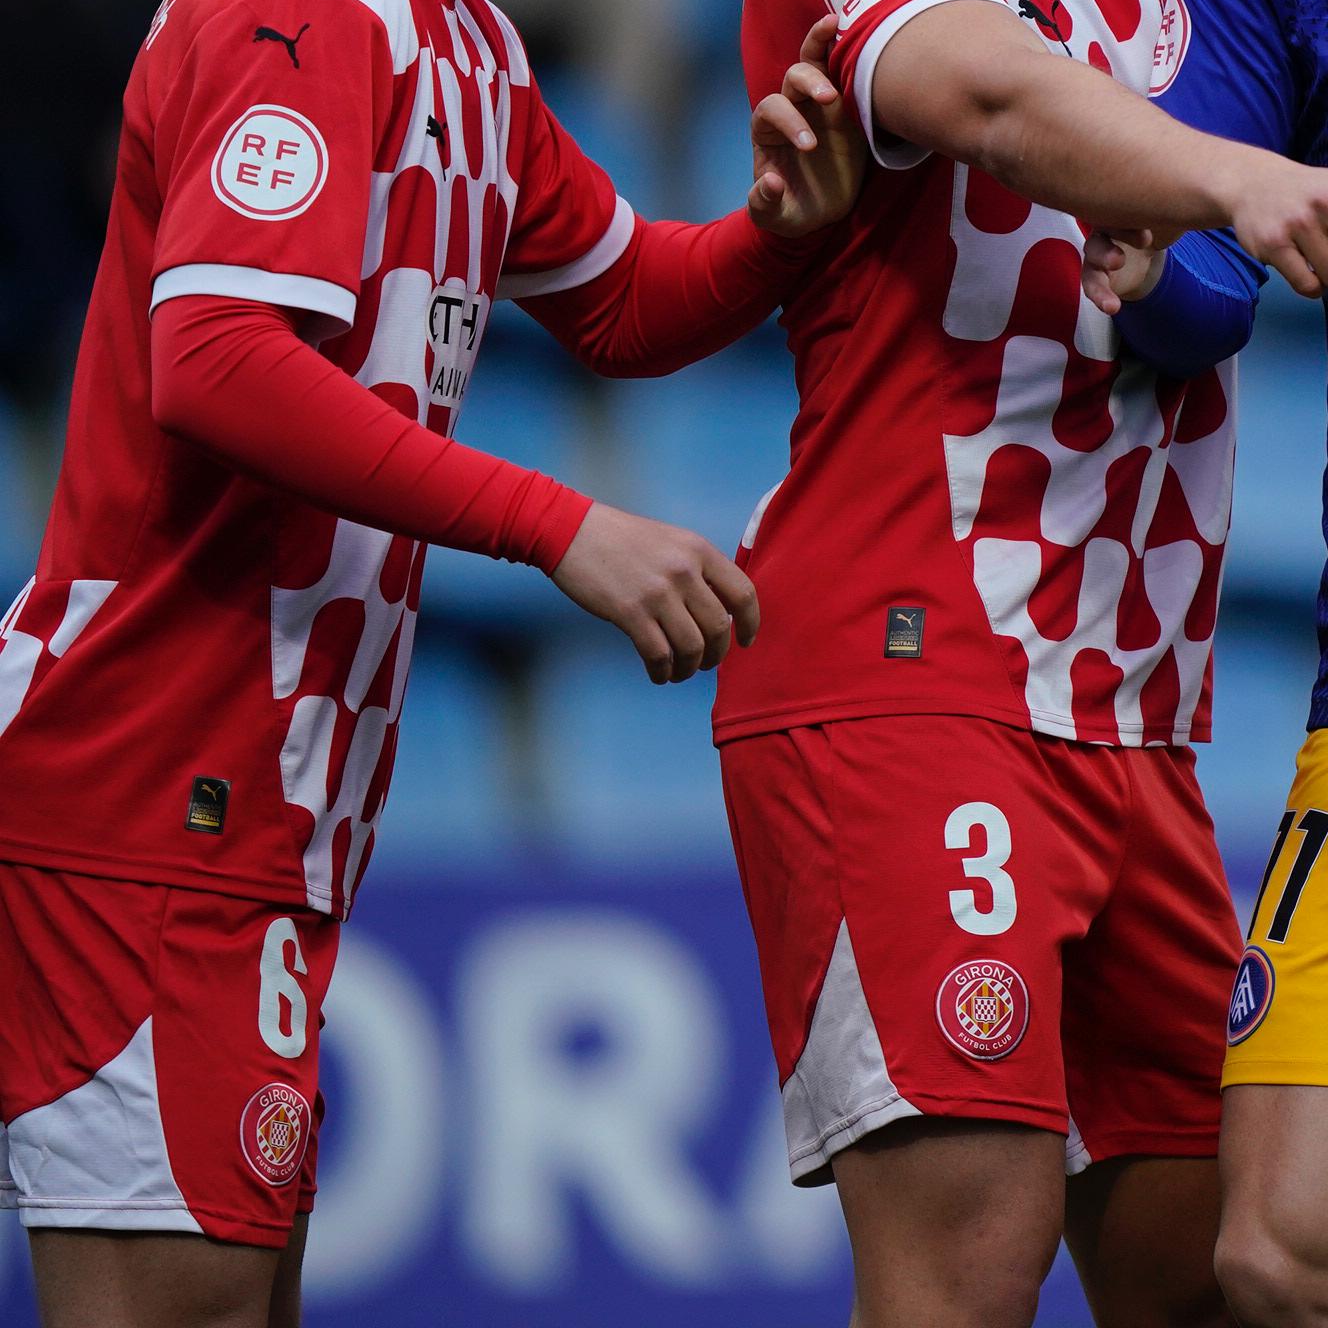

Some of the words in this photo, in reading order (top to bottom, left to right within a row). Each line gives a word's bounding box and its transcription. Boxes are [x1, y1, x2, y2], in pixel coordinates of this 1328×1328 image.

[191, 812, 220, 822] FOOTBALL
[944, 801, 1018, 936] 3
[258, 917, 308, 1059] 6
[955, 965, 1013, 989] GIRONA
[958, 1032, 990, 1051] FUTBOL
[992, 1034, 1012, 1050] CLUB
[259, 1089, 304, 1116] GIRONA
[255, 1155, 279, 1176] FUTBOL
[280, 1161, 295, 1176] CLUB
